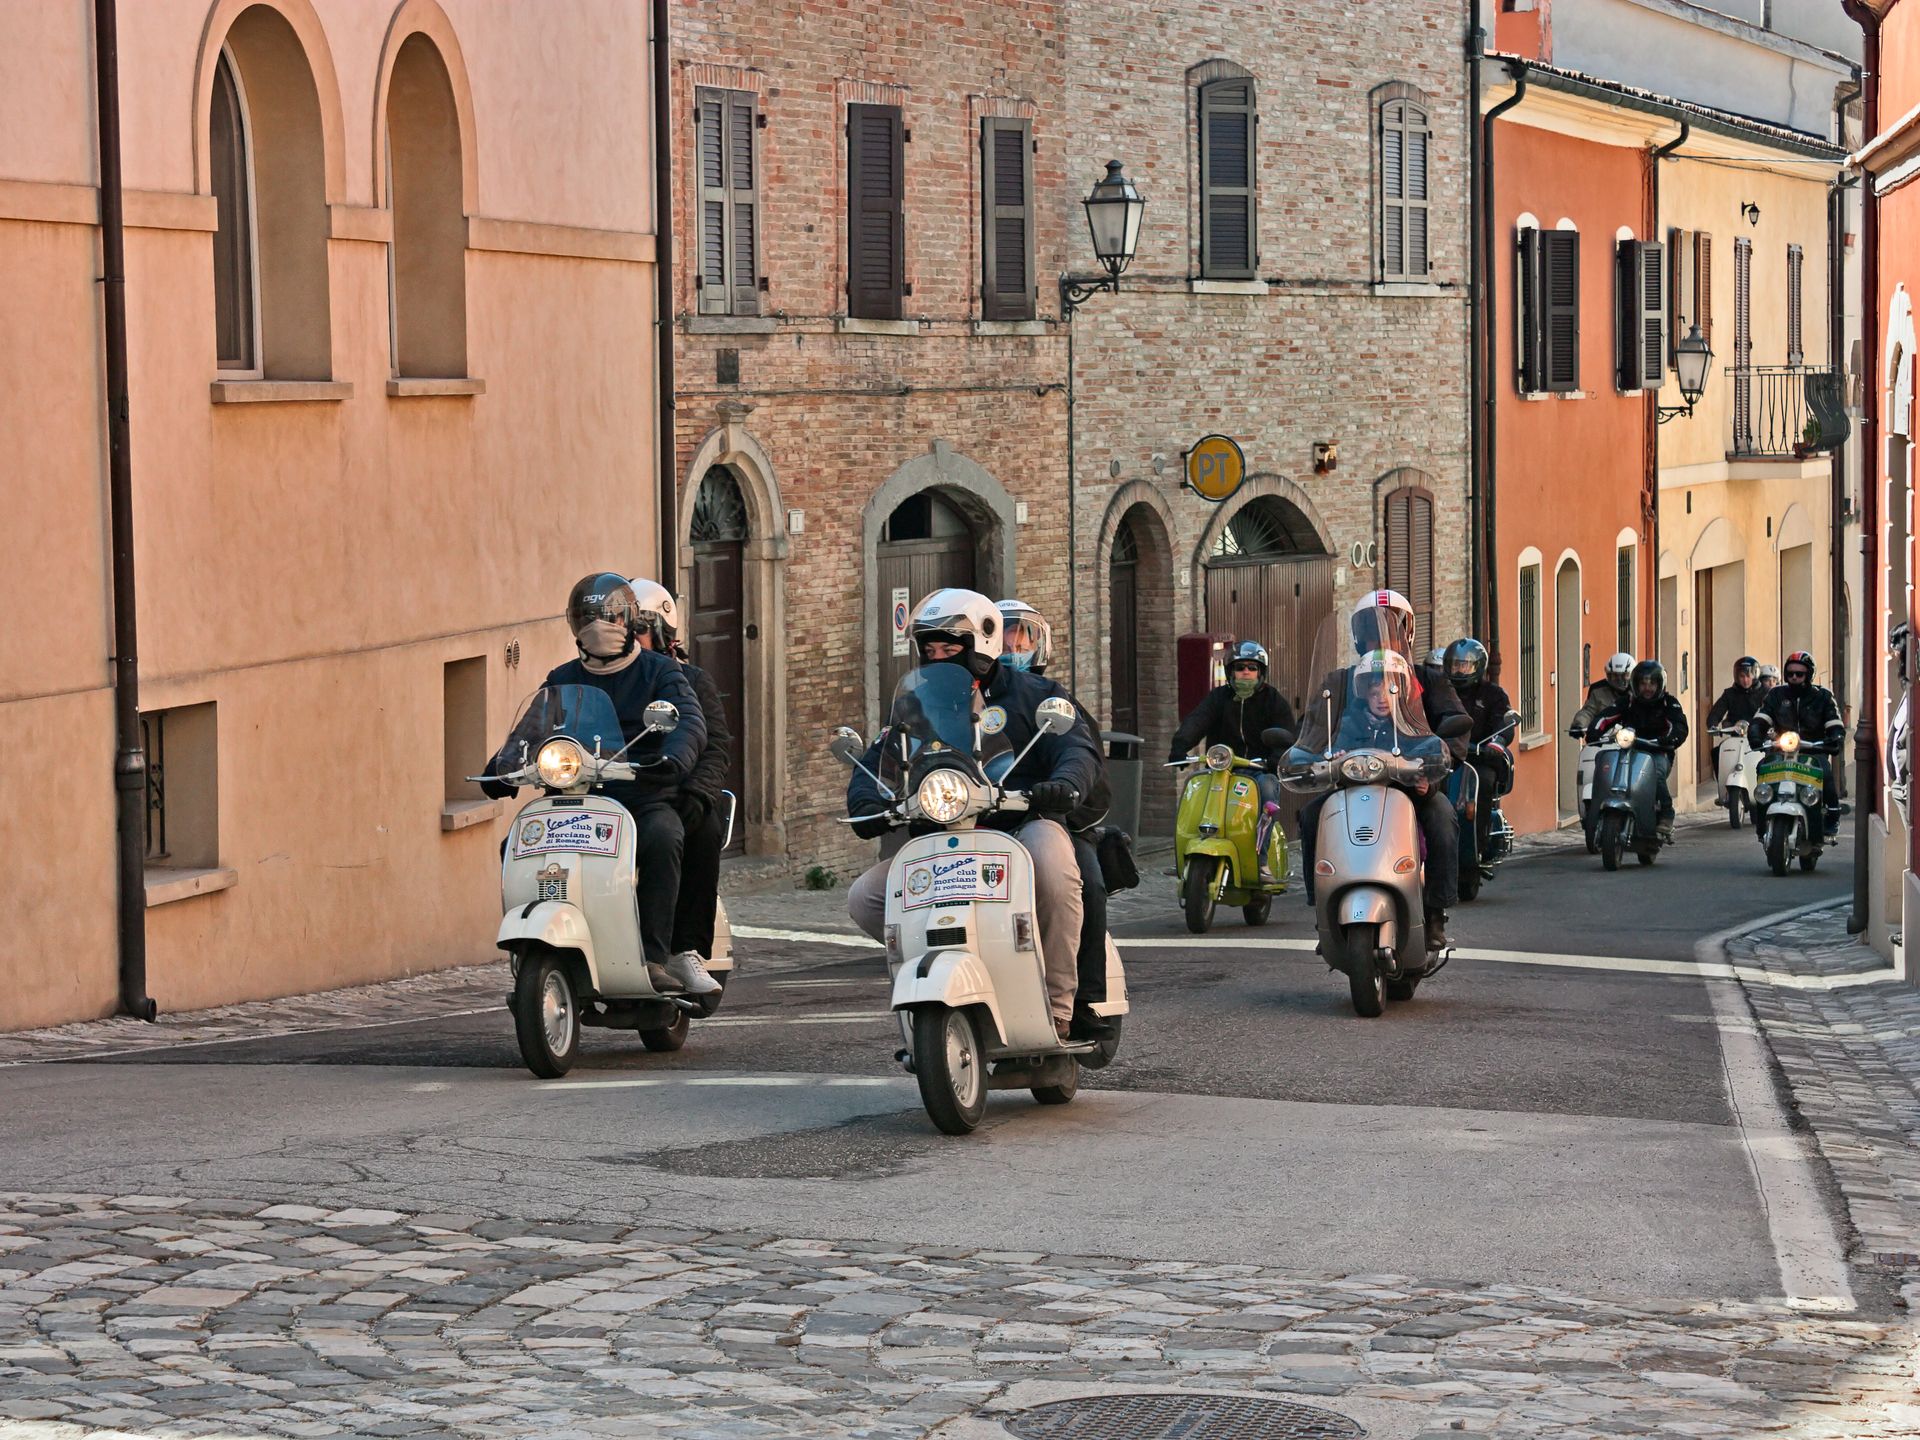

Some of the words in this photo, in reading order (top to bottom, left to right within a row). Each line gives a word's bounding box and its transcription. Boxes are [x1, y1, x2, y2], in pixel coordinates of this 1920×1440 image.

[1198, 452, 1230, 485] PT
[583, 594, 606, 603] agv
[547, 814, 592, 832] Vespa
[546, 831, 591, 839] Morciano
[933, 857, 976, 878] Vespa
[956, 868, 977, 876] club
[934, 877, 977, 885] morciano
